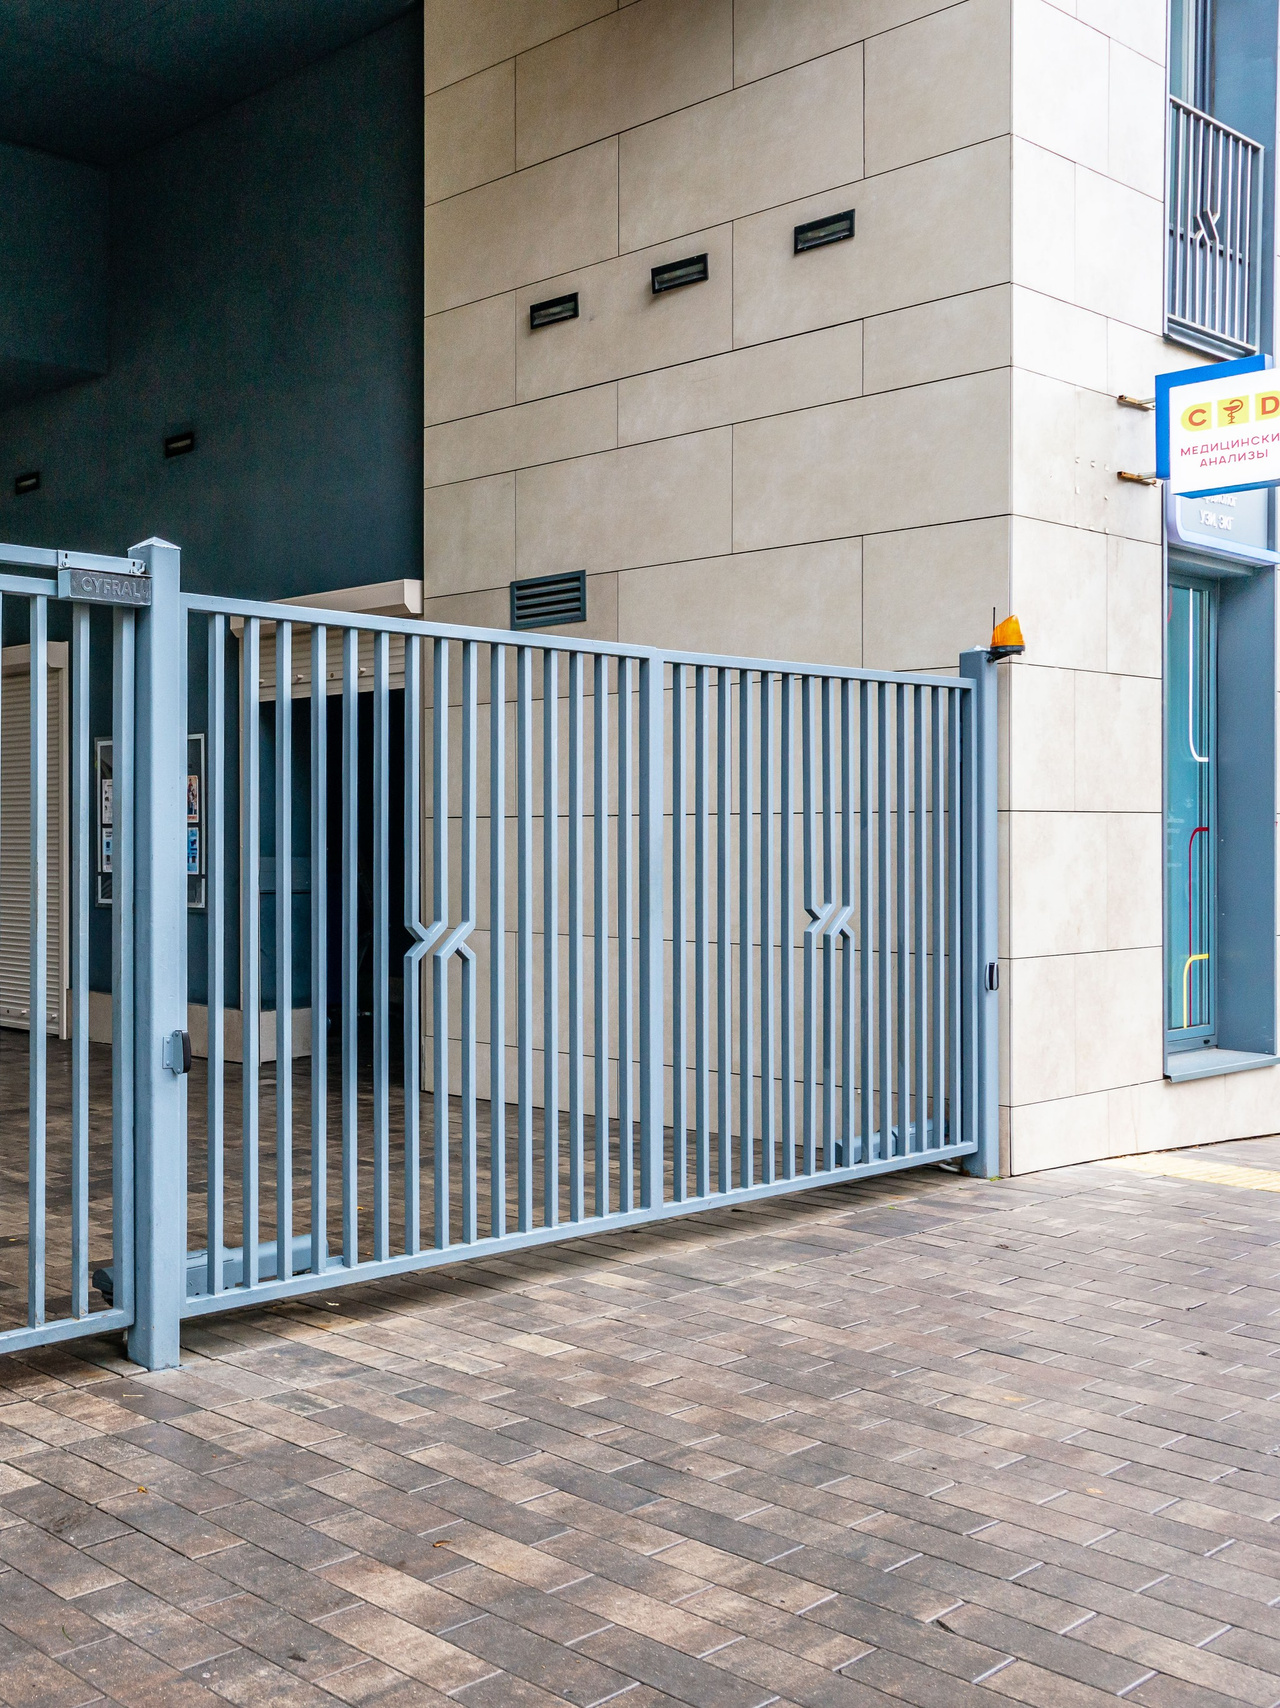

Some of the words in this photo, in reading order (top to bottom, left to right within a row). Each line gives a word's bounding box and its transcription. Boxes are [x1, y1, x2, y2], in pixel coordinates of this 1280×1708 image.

[1261, 396, 1280, 416] D
[1200, 449, 1268, 467] АНАЛИЗЫ
[81, 576, 141, 597] CYFRAL
